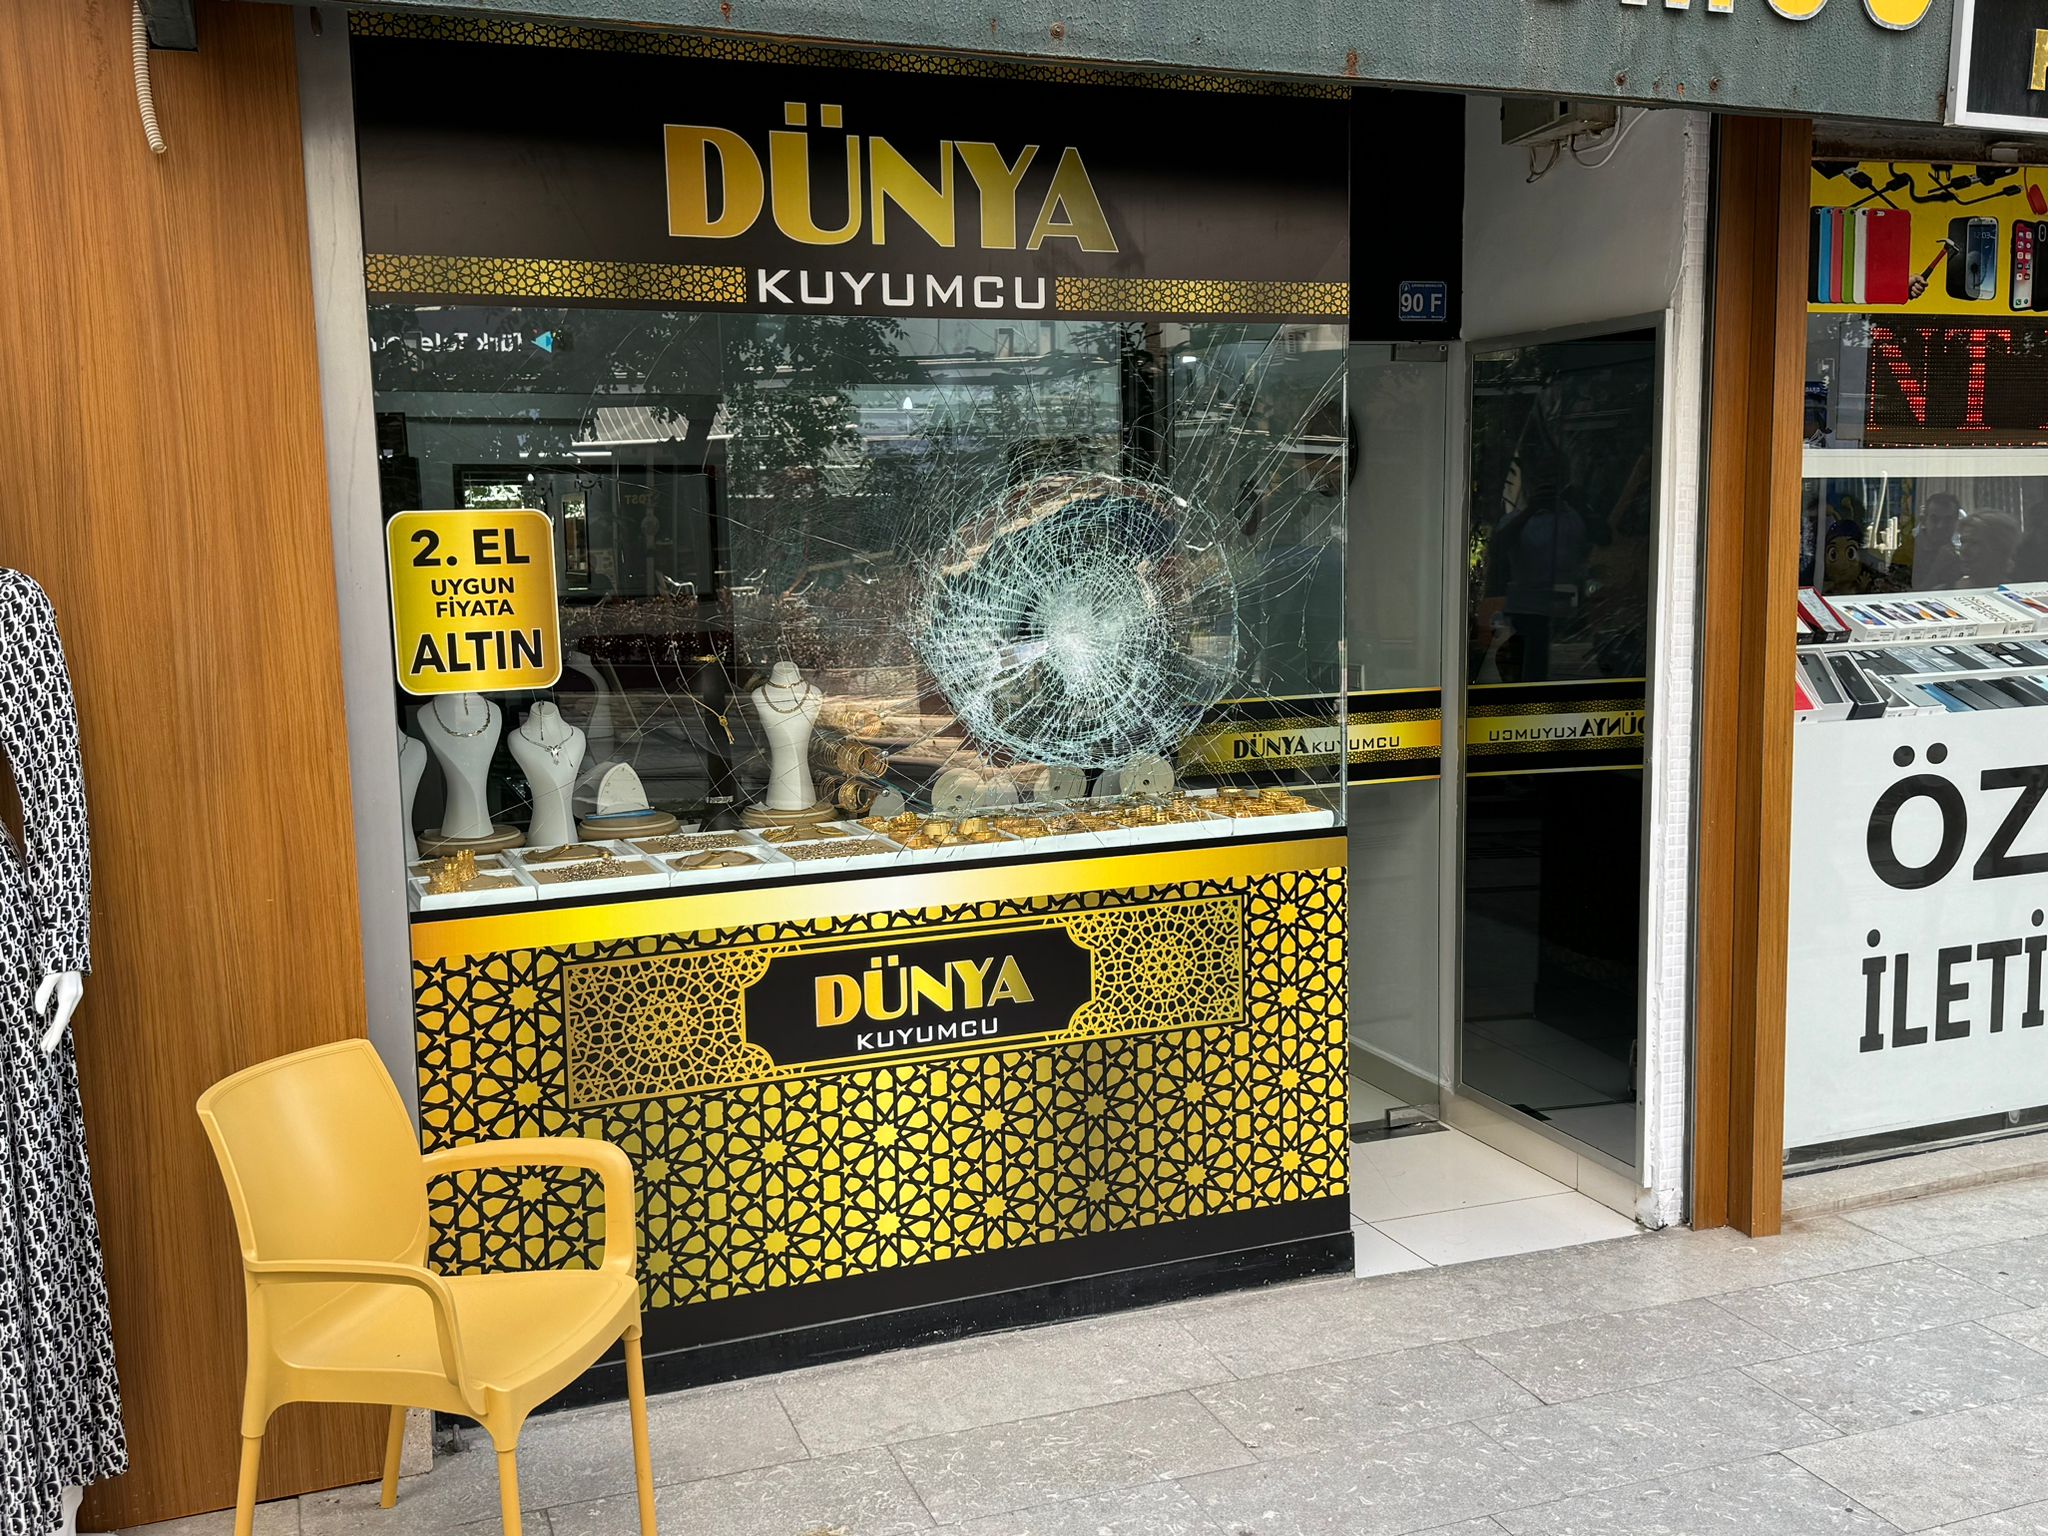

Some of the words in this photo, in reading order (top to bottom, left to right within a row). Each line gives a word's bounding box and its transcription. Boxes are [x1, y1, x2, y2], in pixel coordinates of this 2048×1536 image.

[663, 101, 1119, 253] DÜNYA
[757, 268, 1046, 310] KUYUMCU
[1401, 293, 1424, 312] 90
[1430, 293, 1442, 312] F
[410, 528, 459, 567] 2.
[473, 528, 530, 565] EL
[431, 577, 515, 596] UYGUN
[436, 597, 515, 618] FİYATA
[410, 627, 544, 676] ALTIN
[1233, 733, 1310, 760] DÜNYA
[1311, 735, 1400, 754] KUUMCU
[814, 954, 1034, 1028] DÜNYA
[1859, 908, 2048, 1053] İLETİ
[856, 1017, 999, 1051] KUYUMCU
